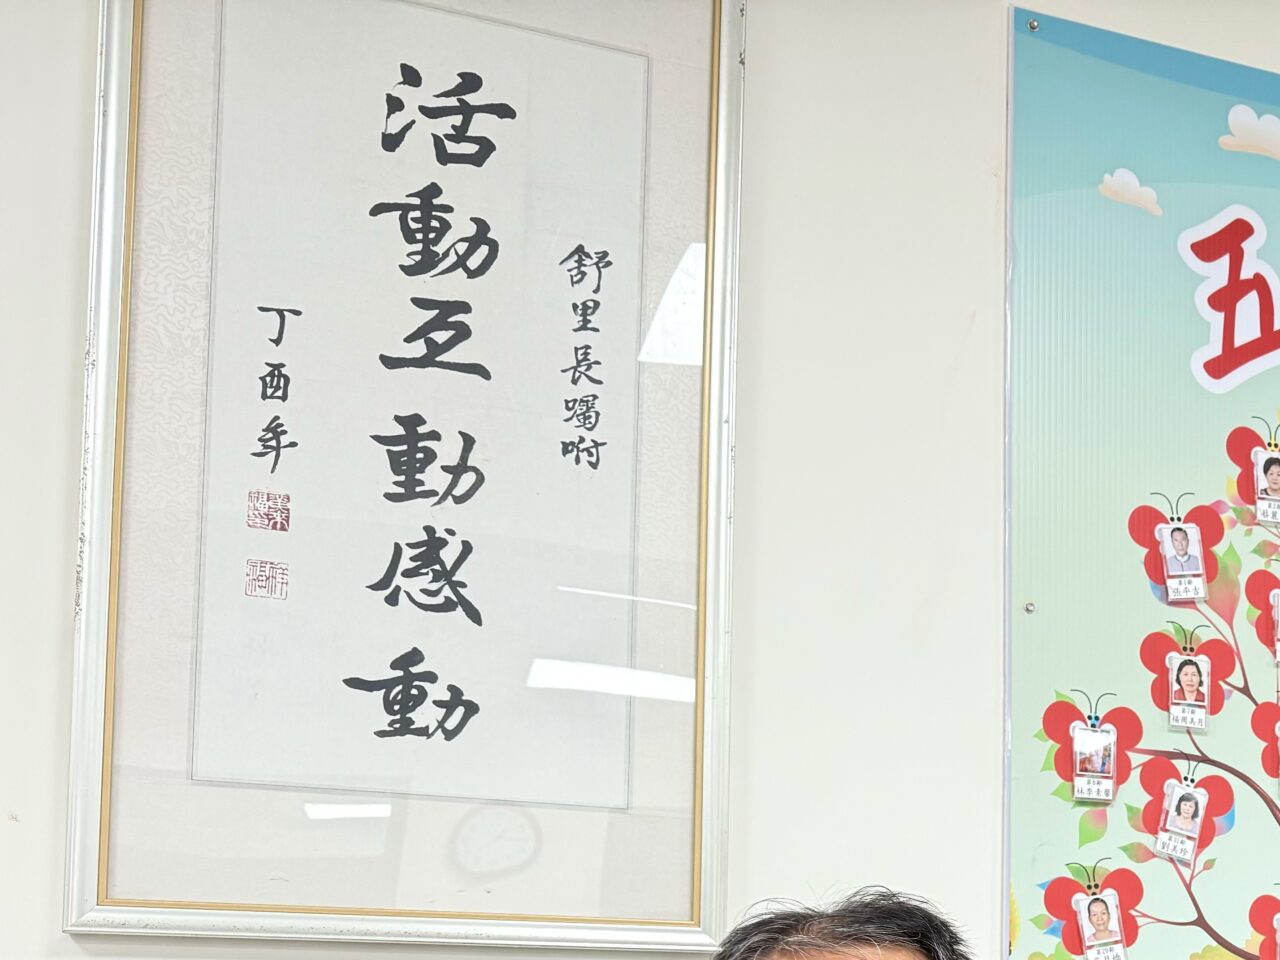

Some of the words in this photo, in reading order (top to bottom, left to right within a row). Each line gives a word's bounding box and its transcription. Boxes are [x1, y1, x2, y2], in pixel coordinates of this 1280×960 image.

[249, 305, 303, 475] 丁酉年
[342, 62, 517, 743] 活動互動感動
[558, 243, 614, 471] 舒里長囑咐
